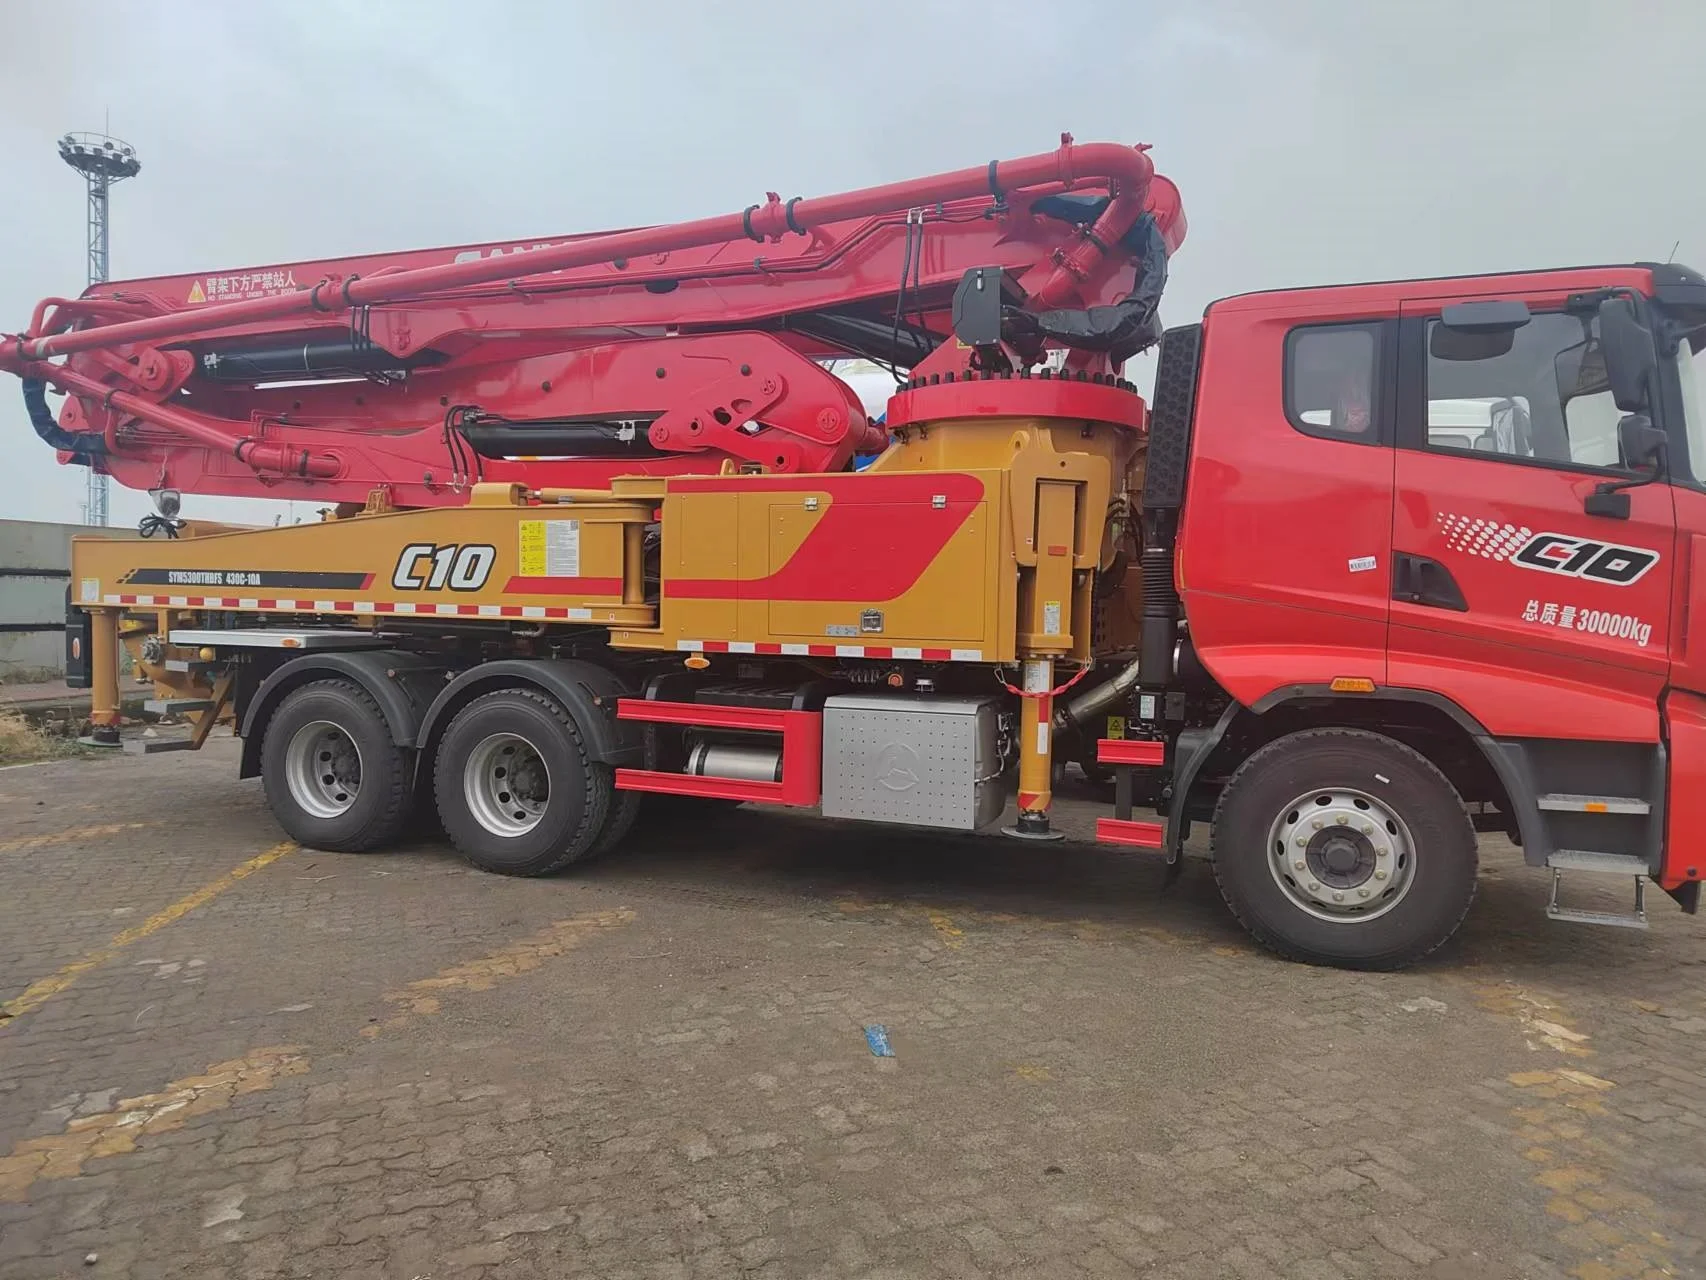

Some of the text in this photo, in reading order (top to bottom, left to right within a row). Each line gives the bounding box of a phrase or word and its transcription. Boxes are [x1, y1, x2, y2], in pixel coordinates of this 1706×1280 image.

[206, 271, 297, 295] 臂架下方严禁站人
[392, 543, 496, 592] C10
[1509, 532, 1660, 586] C10
[1521, 600, 1652, 647] 总质量30000kg
